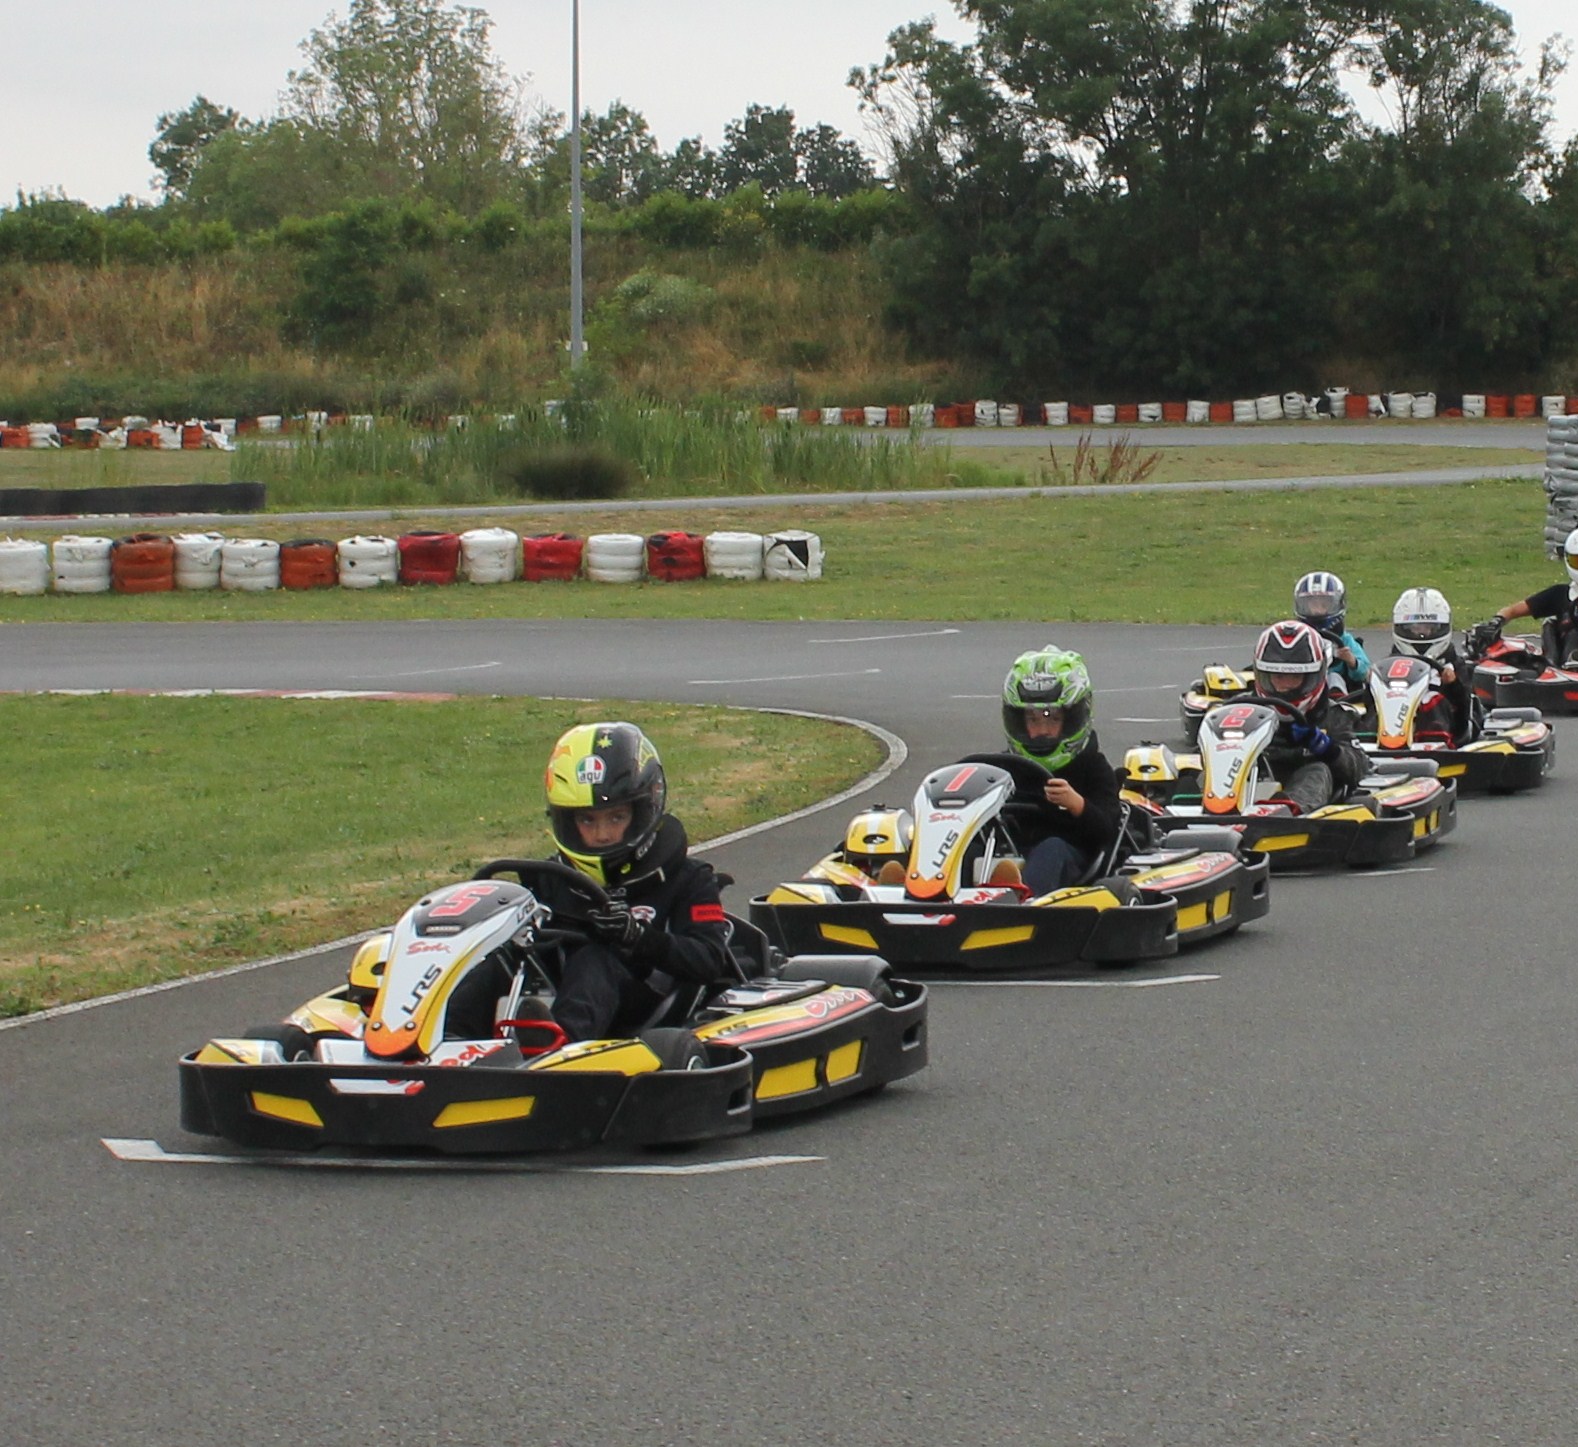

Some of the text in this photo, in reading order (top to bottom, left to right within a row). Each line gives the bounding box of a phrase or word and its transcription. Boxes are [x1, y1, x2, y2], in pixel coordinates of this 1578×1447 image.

[1387, 659, 1413, 678] 6
[1219, 706, 1255, 728] 2
[944, 767, 979, 792] 1
[932, 829, 959, 869] LRS
[428, 885, 499, 917] 5
[401, 963, 444, 1015] LRS
